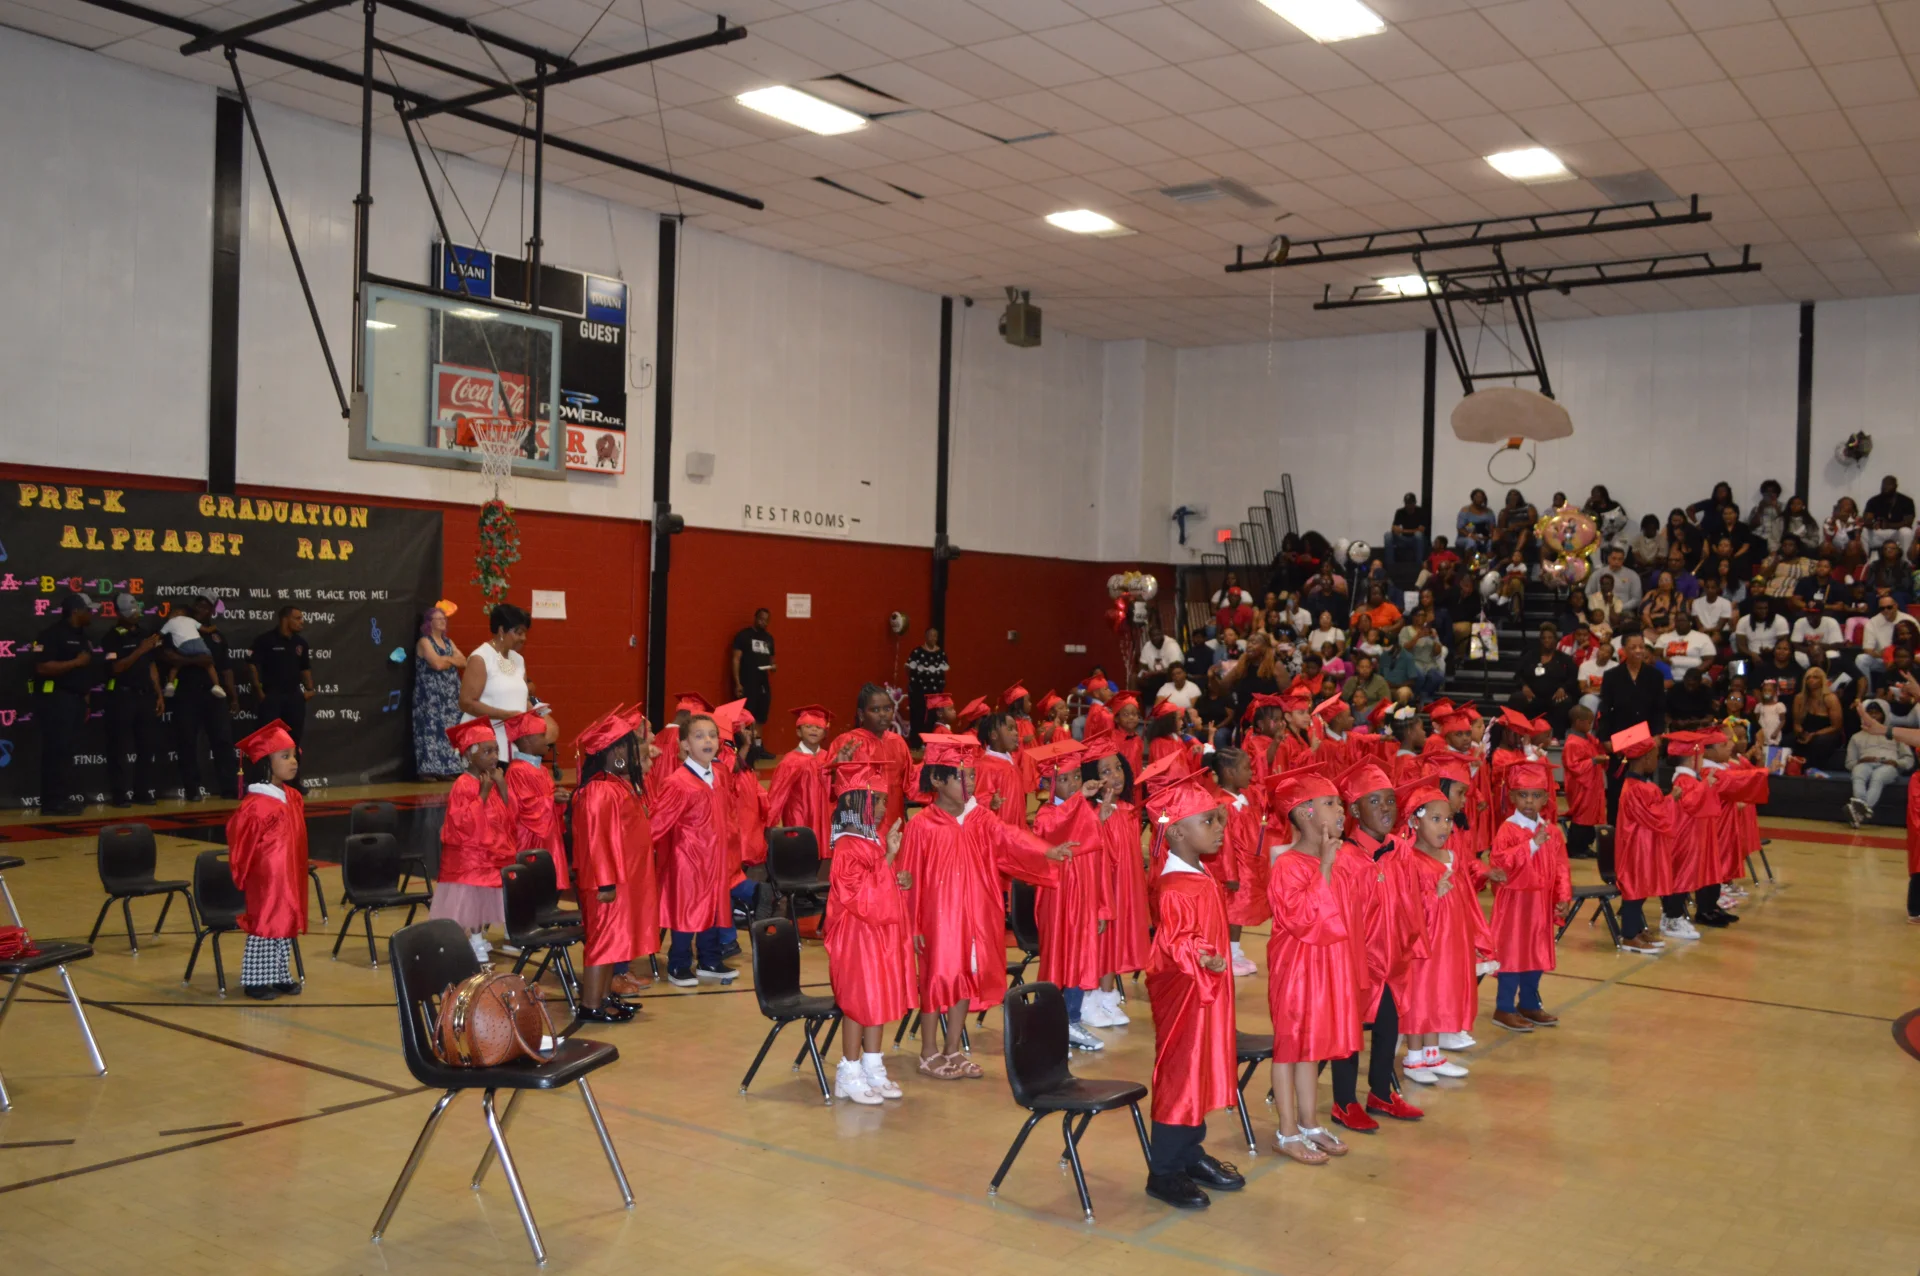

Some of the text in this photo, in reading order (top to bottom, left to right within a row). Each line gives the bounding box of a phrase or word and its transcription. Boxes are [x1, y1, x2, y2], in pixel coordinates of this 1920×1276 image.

[580, 320, 621, 345] GUEST
[18, 483, 369, 528] PRE-K GRADUATION
[744, 504, 845, 528] RESTROOMS
[60, 525, 355, 561] ALPHABET RAP
[249, 588, 271, 598] WILL
[277, 589, 289, 599] BE
[293, 589, 312, 599] THE
[317, 589, 345, 600] PLACE
[349, 590, 367, 600] FOR
[371, 591, 389, 600] ME!
[223, 609, 246, 619] OUR
[249, 609, 275, 620] BEST
[315, 649, 332, 659] GO!
[315, 709, 335, 719] AND
[340, 709, 362, 722] TRY.
[73, 754, 107, 765] FINIS
[21, 797, 42, 807] WE
